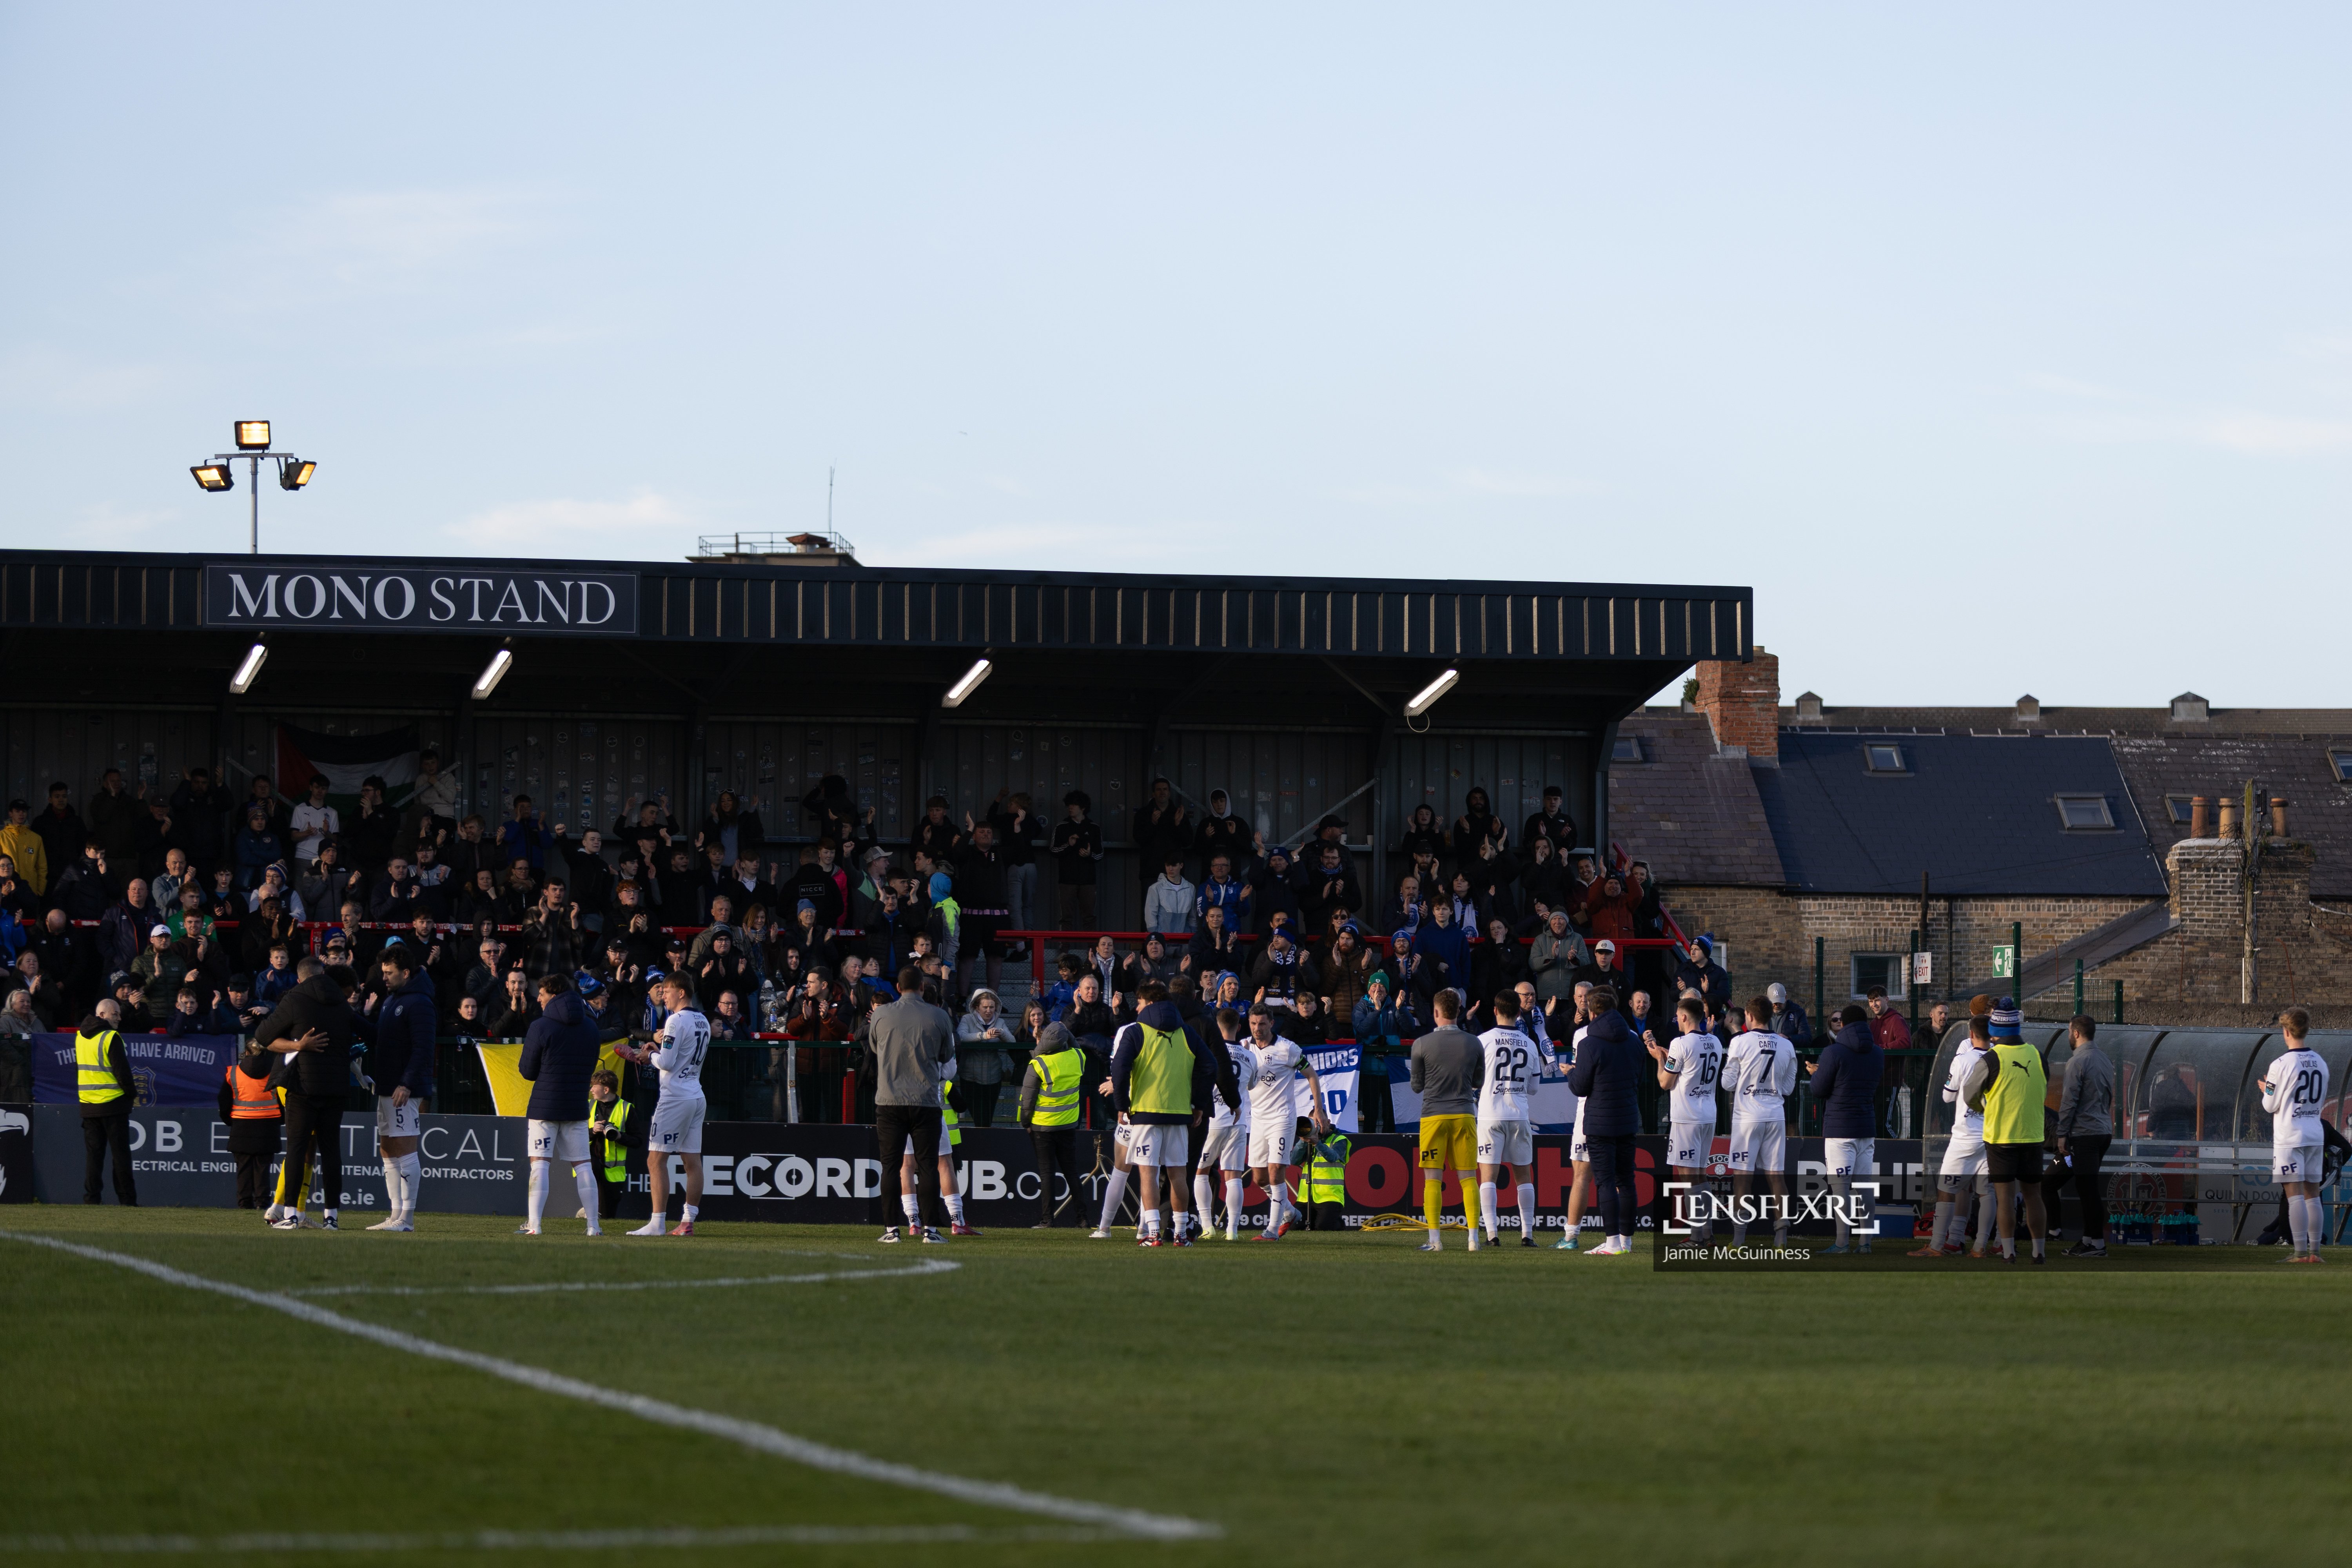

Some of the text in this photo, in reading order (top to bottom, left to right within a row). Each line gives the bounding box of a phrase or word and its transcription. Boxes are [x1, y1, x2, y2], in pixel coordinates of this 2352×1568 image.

[228, 574, 615, 624] MONO STAND
[1918, 967, 1928, 976] EXIT
[690, 1031, 709, 1066] 10
[1495, 1038, 1528, 1047] MANSFIELD
[131, 1042, 162, 1057] HAVE
[164, 1044, 215, 1065] ARRIVED
[1305, 1048, 1358, 1071] NIORS
[1495, 1047, 1528, 1082] 22
[1700, 1052, 1718, 1085] 16
[1759, 1049, 1777, 1083] 7
[1743, 1084, 1778, 1096] Supermac's
[2294, 1069, 2322, 1104] 20
[396, 1109, 404, 1124] 5
[664, 1132, 679, 1145] PF
[1118, 1126, 1131, 1139] PF
[535, 1137, 551, 1149] PF
[1279, 1137, 1285, 1151] 9
[1478, 1143, 1492, 1156] PF
[1136, 1144, 1150, 1157] PF
[1422, 1149, 1438, 1161] PF
[1679, 1149, 1695, 1160] PF
[1732, 1151, 1748, 1162] PF
[132, 1160, 198, 1172] ECTRICAL
[421, 1167, 514, 1181] ONTRACTORS
[1836, 1165, 1851, 1178] PF
[2281, 1162, 2297, 1175] PF
[1944, 1174, 1961, 1185] PF
